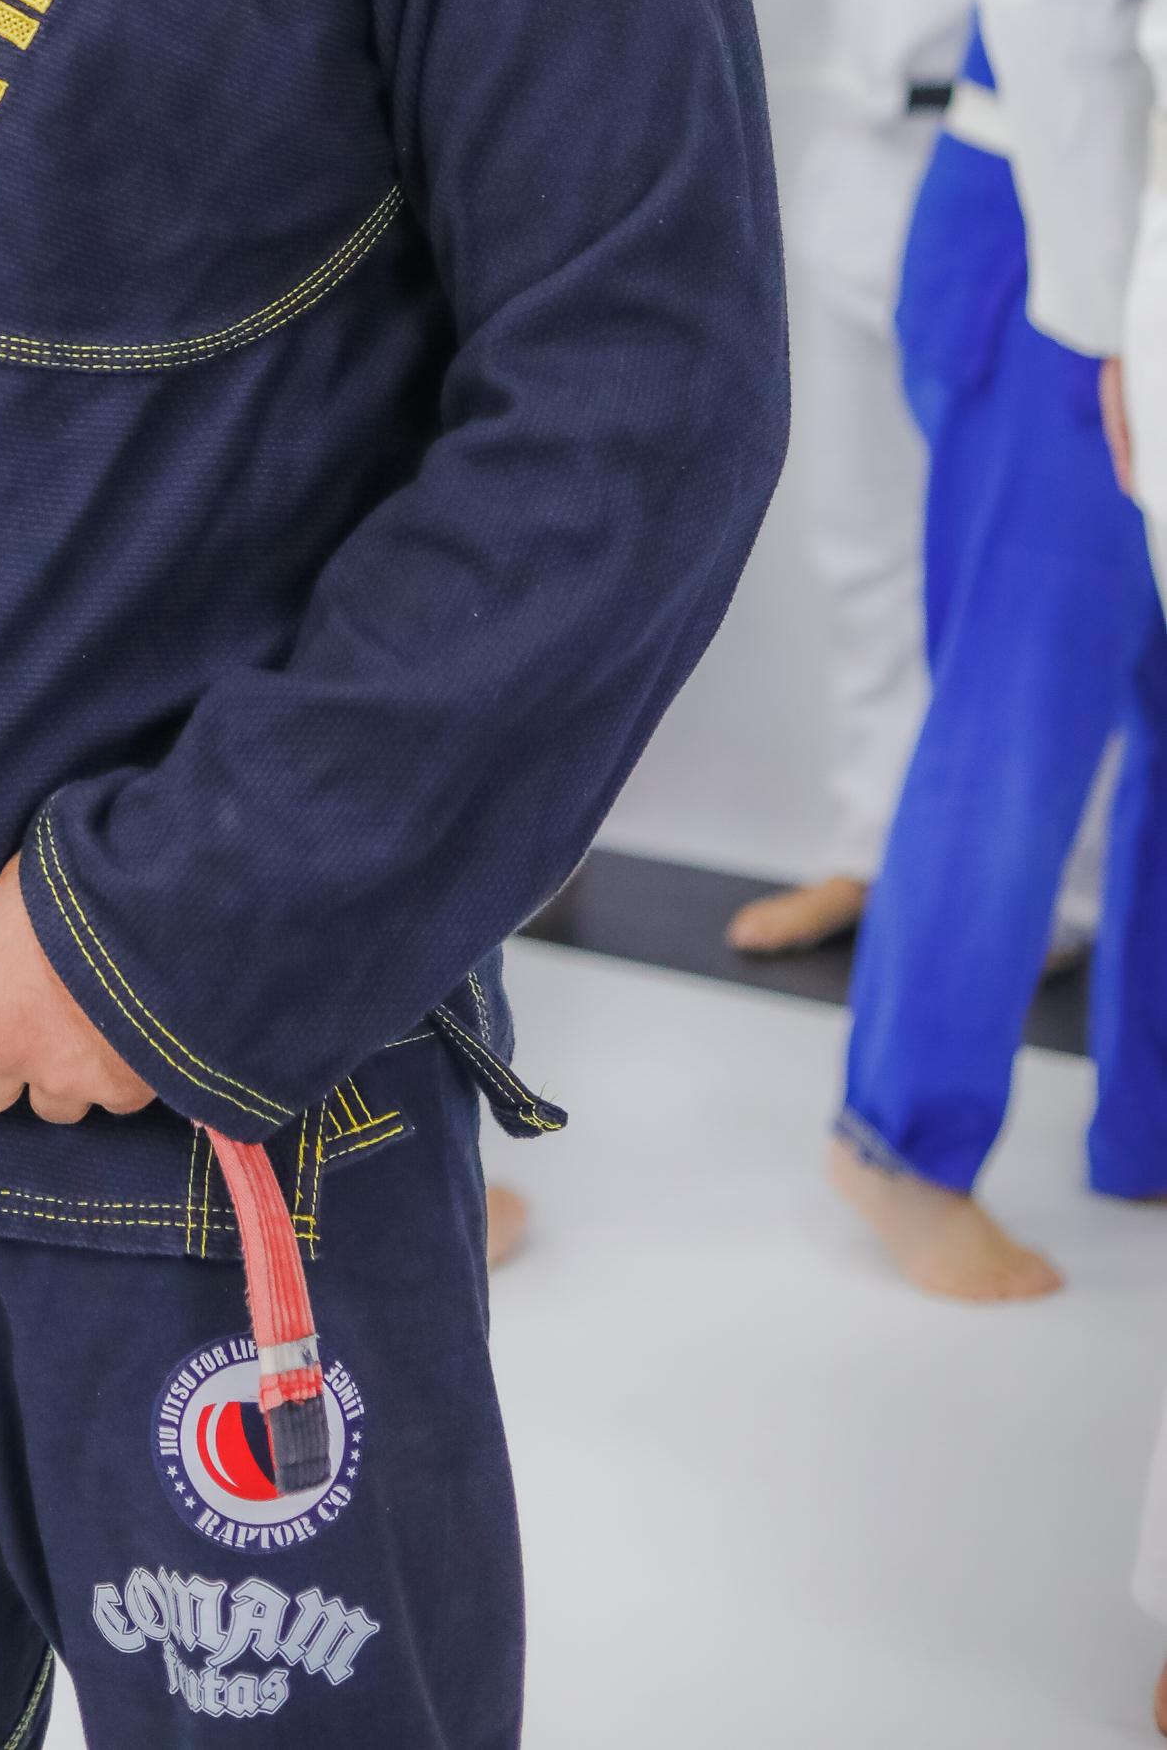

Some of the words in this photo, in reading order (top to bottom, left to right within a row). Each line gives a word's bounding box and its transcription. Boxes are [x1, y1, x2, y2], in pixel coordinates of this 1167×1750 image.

[189, 1345, 230, 1379] FOR
[229, 1338, 258, 1361] LIF
[160, 1370, 198, 1425] JITSU
[158, 1425, 180, 1457] JIU
[194, 1506, 317, 1549] RAPTOR
[317, 1484, 353, 1522] CO
